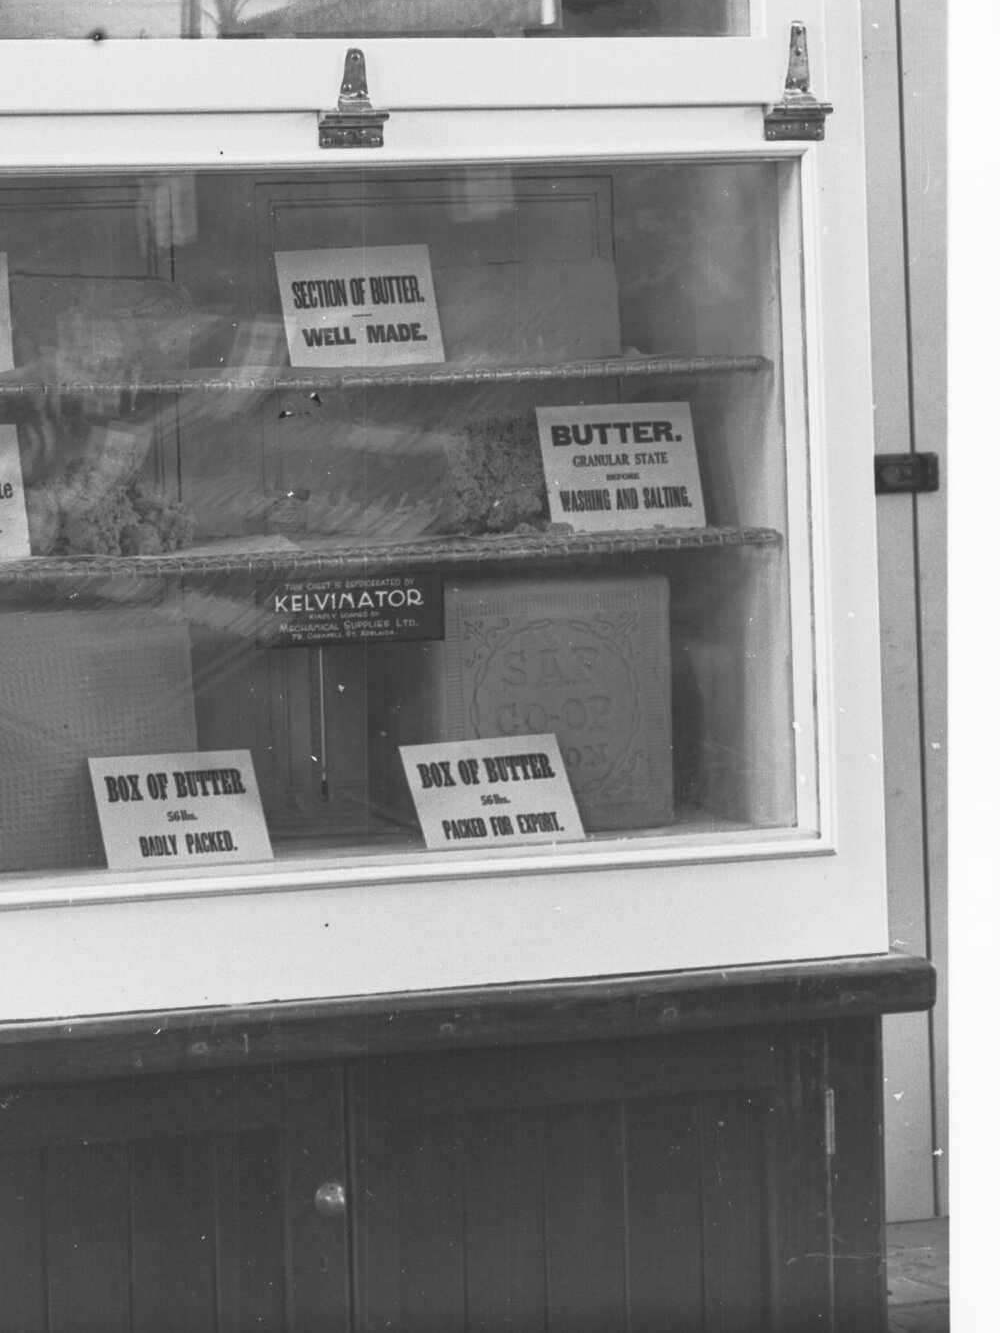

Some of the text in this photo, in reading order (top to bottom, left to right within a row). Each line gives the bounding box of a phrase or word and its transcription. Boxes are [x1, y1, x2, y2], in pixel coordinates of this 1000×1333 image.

[291, 275, 425, 309] SECTION OF BUTTER.
[302, 323, 428, 347] WELL MADE.
[551, 421, 682, 446] BUTTER.
[573, 452, 668, 467] GRANULAR STATE
[606, 472, 640, 481] BEFORE
[559, 486, 693, 512] WASHING AND SALTING.
[306, 582, 331, 590] CHEST
[334, 581, 342, 589] IS
[404, 578, 415, 586] BY
[275, 589, 424, 612] KELVINATOR
[279, 623, 339, 633] MECHANICAL
[344, 619, 390, 630] SUPPLIES
[416, 761, 456, 789] BOX
[458, 759, 480, 785] OF
[104, 774, 143, 803] BOX
[146, 772, 168, 801] OF
[442, 811, 564, 840] PACKED FOR EXPORT.
[139, 830, 238, 858] BADLY PACKED.
